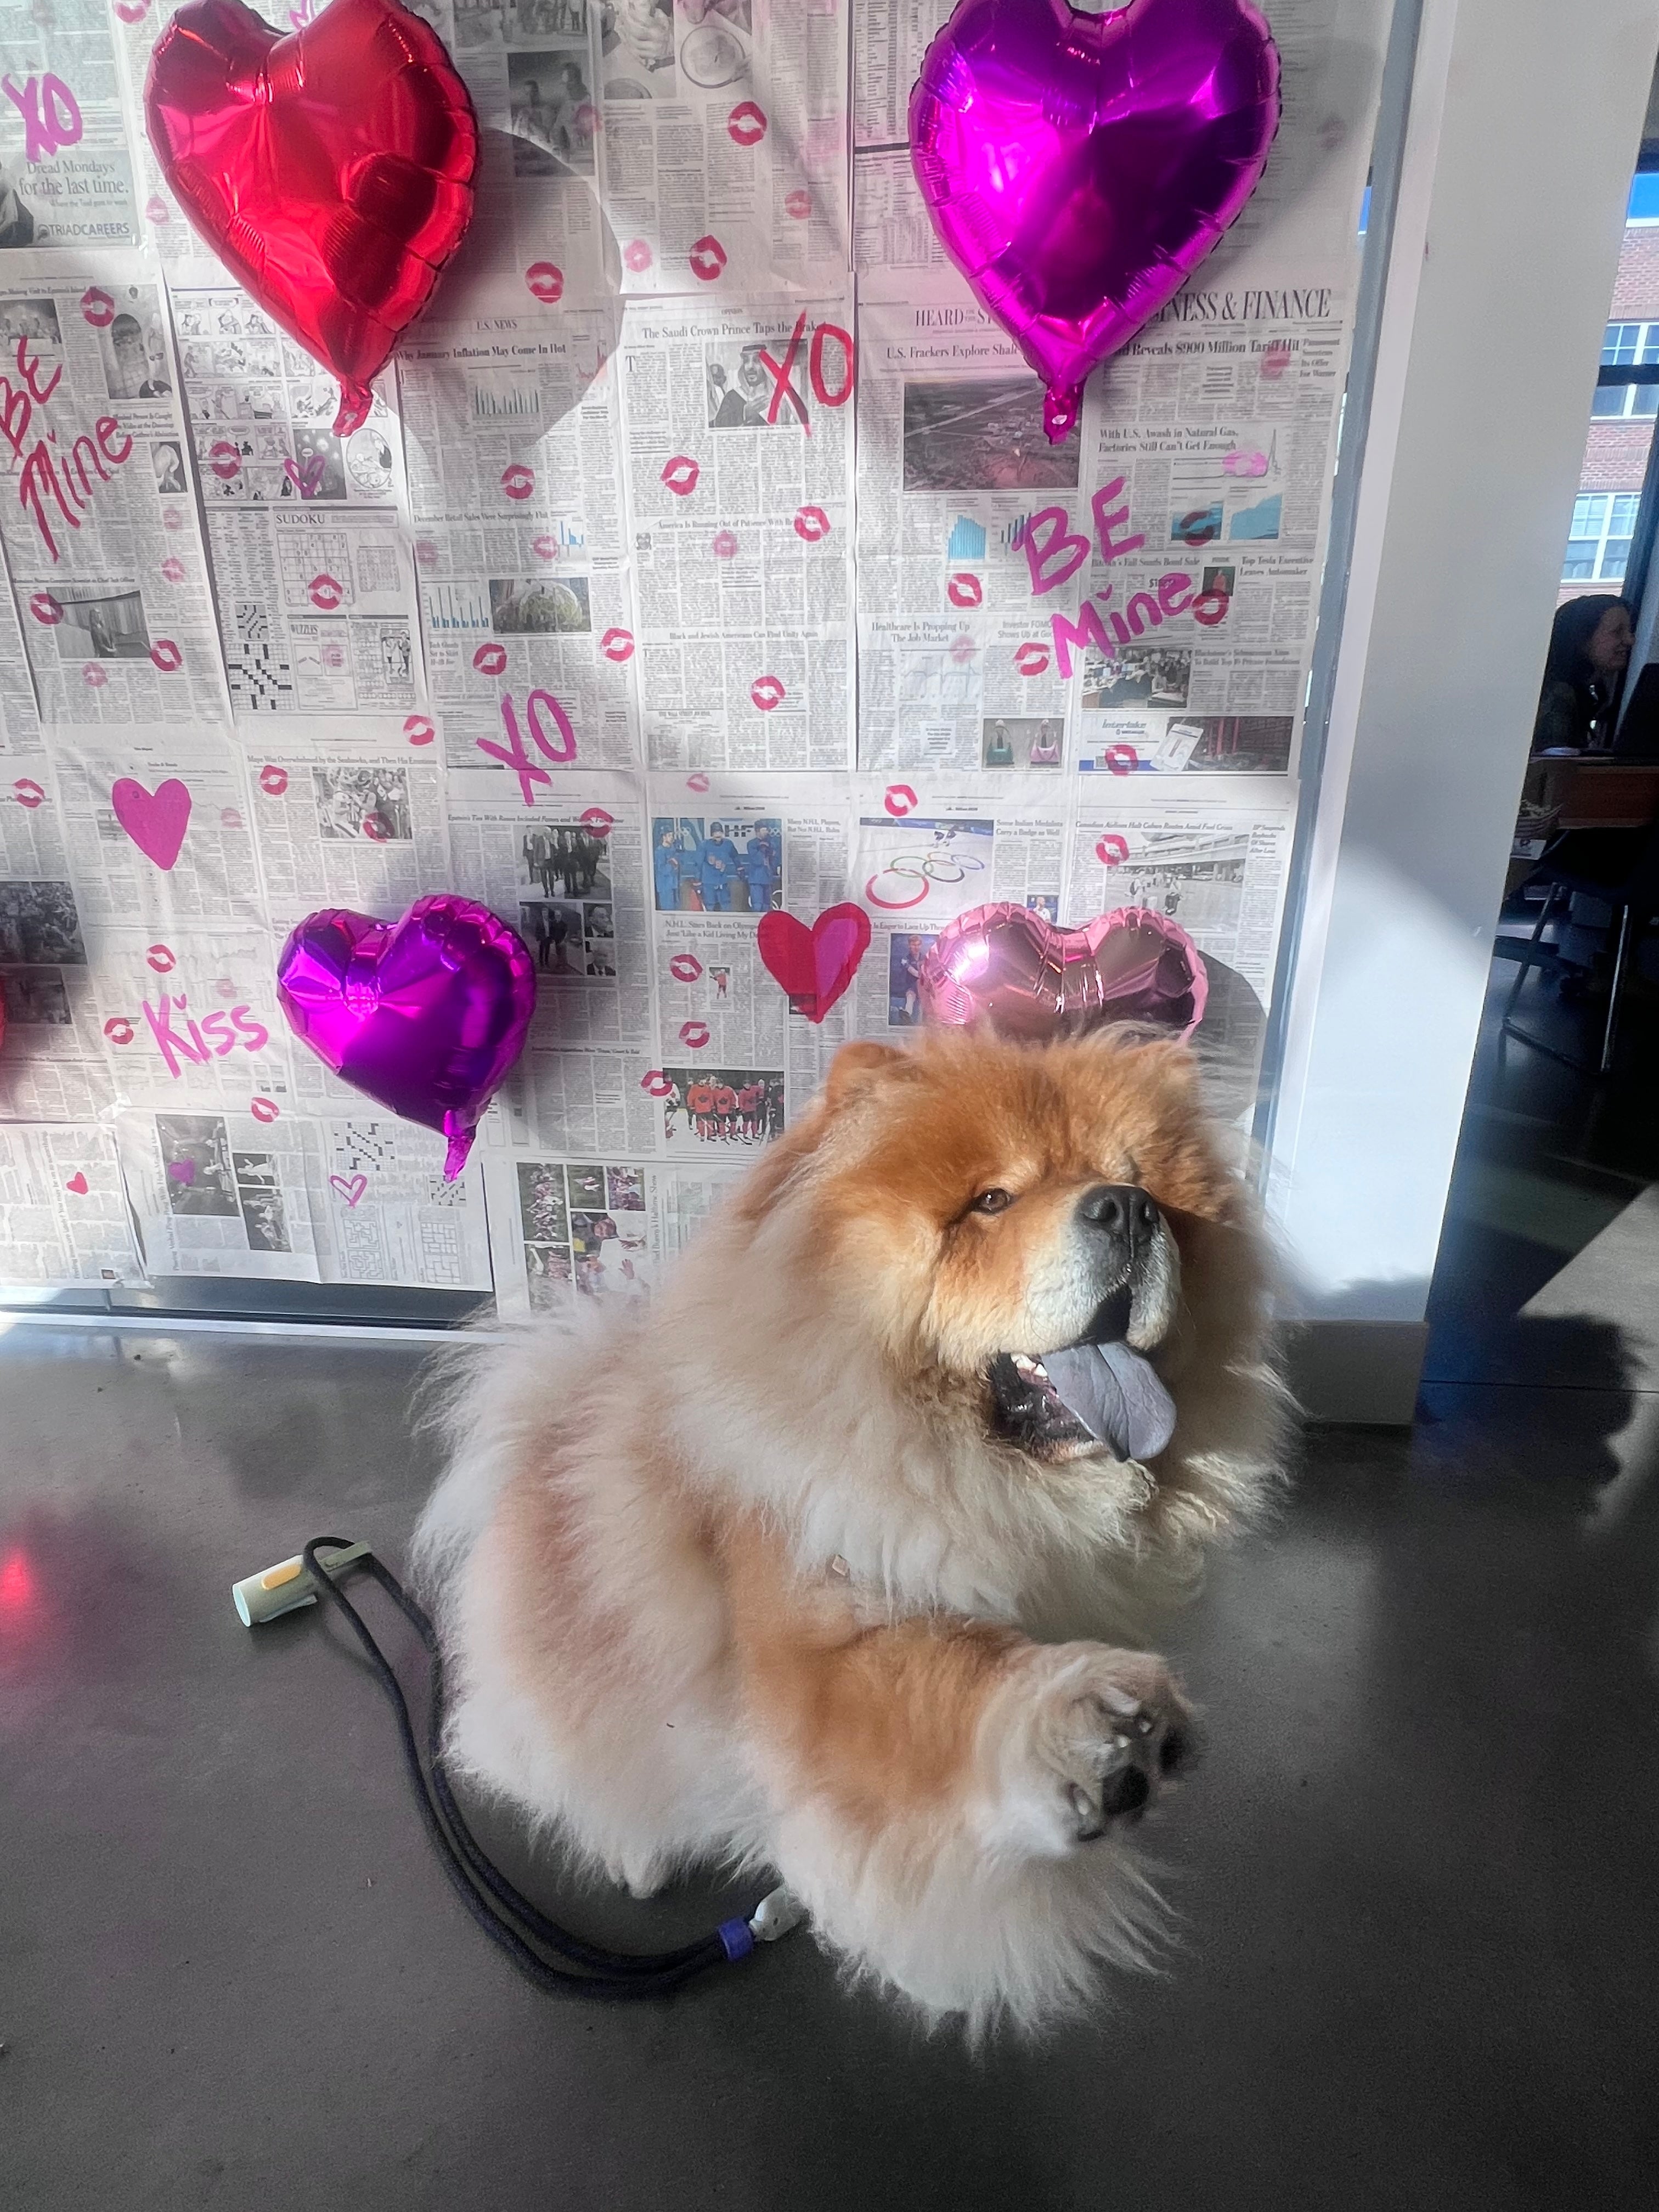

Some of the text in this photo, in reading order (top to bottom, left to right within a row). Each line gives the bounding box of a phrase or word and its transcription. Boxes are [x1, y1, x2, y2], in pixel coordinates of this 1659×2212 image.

[1, 72, 83, 163] XO
[27, 160, 115, 176] Dread Mondays
[19, 176, 129, 196] for the last time.
[1222, 291, 1237, 320] &
[1243, 289, 1331, 321] FINANCE
[494, 319, 518, 329] NEWS
[915, 309, 964, 326] HEARD
[642, 320, 792, 340] The Saudi Crown Prince Taps the
[398, 350, 413, 362] Why
[453, 347, 490, 358] Inflation
[493, 346, 509, 357] May
[511, 345, 537, 356] Come
[538, 344, 548, 354] In
[550, 343, 566, 354] Hot
[887, 347, 906, 359] U.S.
[910, 346, 949, 358] Frackers
[952, 344, 990, 359] Explore
[1132, 341, 1173, 356] Reveals
[1176, 341, 1205, 354] $900
[1207, 340, 1246, 354] Million
[1249, 339, 1279, 352] Tariff
[759, 306, 855, 438] XO
[1099, 428, 1120, 439] With
[1173, 427, 1182, 438] in
[1186, 426, 1217, 437] Natural
[1098, 442, 1137, 453] Factories
[1139, 441, 1158, 452] Still
[1159, 441, 1183, 451] Can't
[1185, 440, 1200, 450] Get
[275, 514, 326, 524] SUDOKU
[658, 521, 684, 529] America
[1012, 475, 1146, 596] BE
[1241, 556, 1256, 566] Top
[1258, 556, 1276, 565] Tesla
[872, 620, 970, 634] Healthcare Is Propping Up
[1051, 572, 1195, 679] Mine
[890, 632, 949, 643] The Job Market
[476, 689, 577, 807] XO
[919, 923, 929, 932] Up
[142, 992, 269, 1079] Kiss
[649, 1175, 657, 1193] Show
